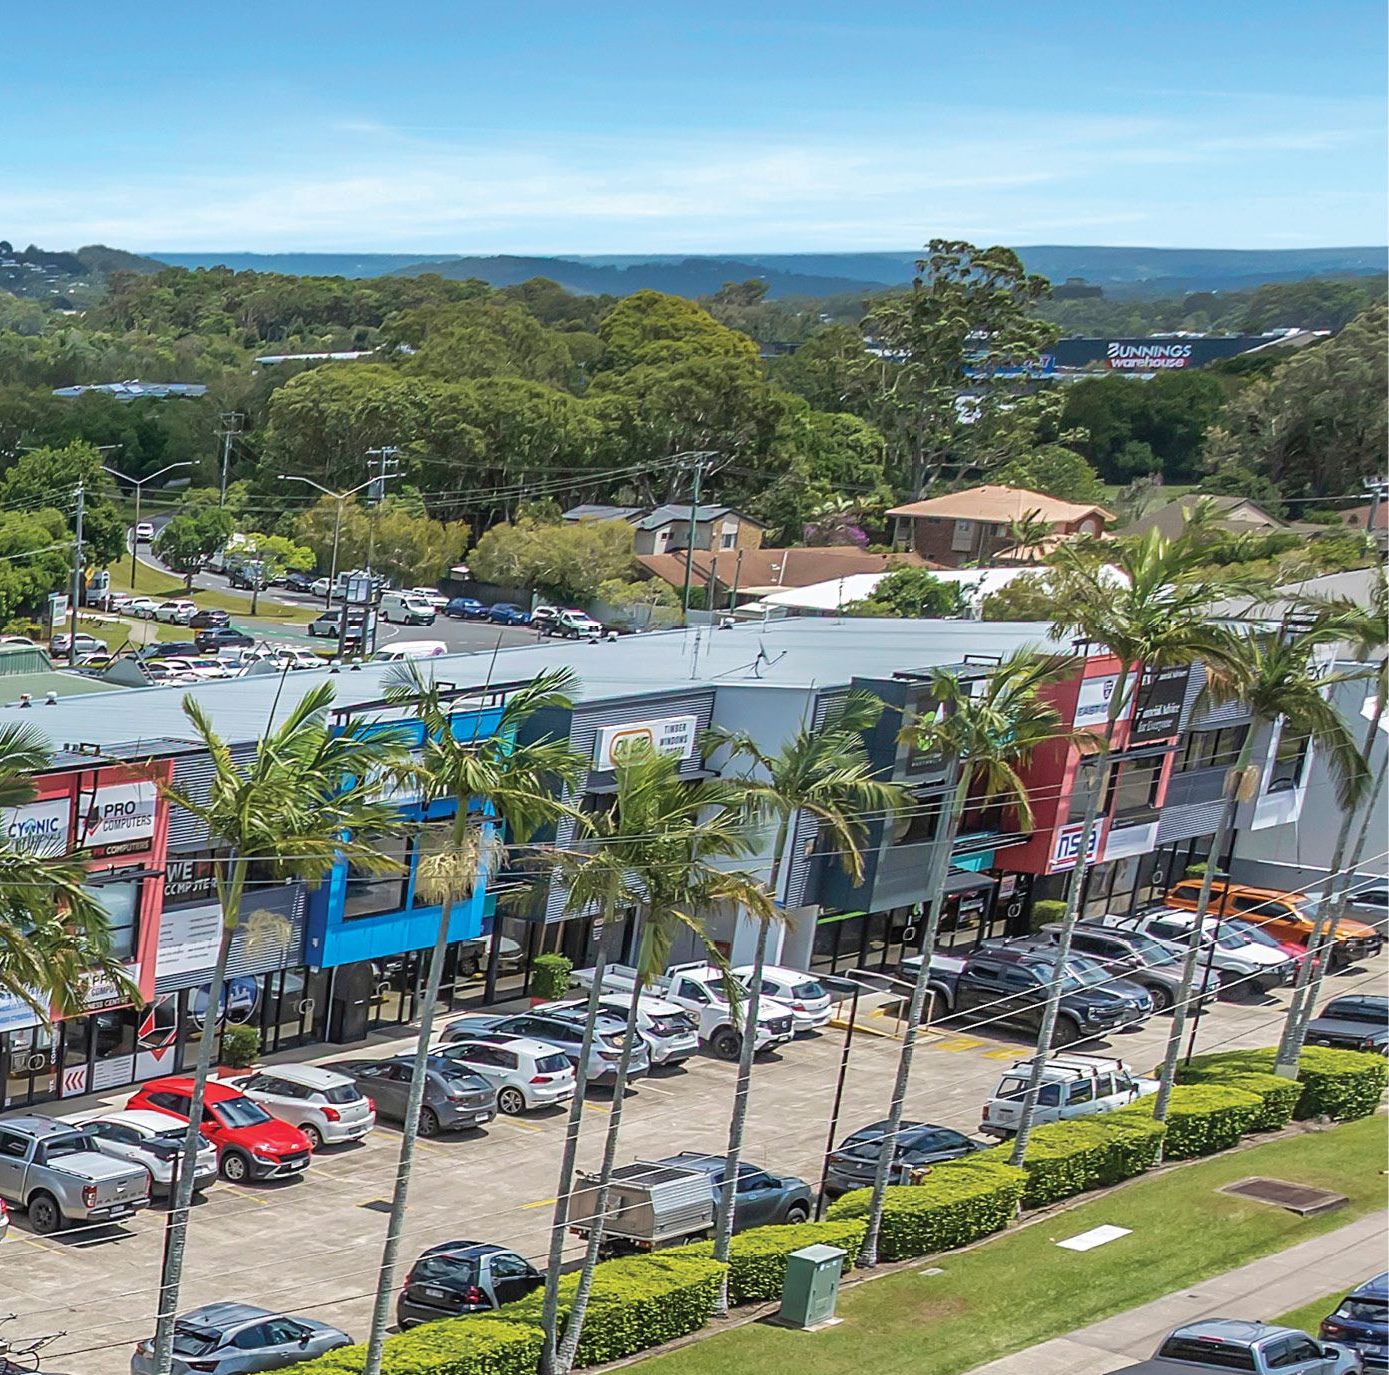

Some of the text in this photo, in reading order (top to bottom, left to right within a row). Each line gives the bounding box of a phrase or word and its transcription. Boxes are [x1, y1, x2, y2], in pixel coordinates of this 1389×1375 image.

[1106, 342, 1192, 357] BUNNINGS
[1109, 356, 1185, 368] warehouse
[664, 723, 687, 734] TIMBER
[659, 734, 688, 746] WINDOWS
[104, 800, 136, 818] PRO
[102, 814, 152, 832] COMPUTERS
[106, 840, 150, 855] COMPUTERS
[166, 861, 193, 882] WE
